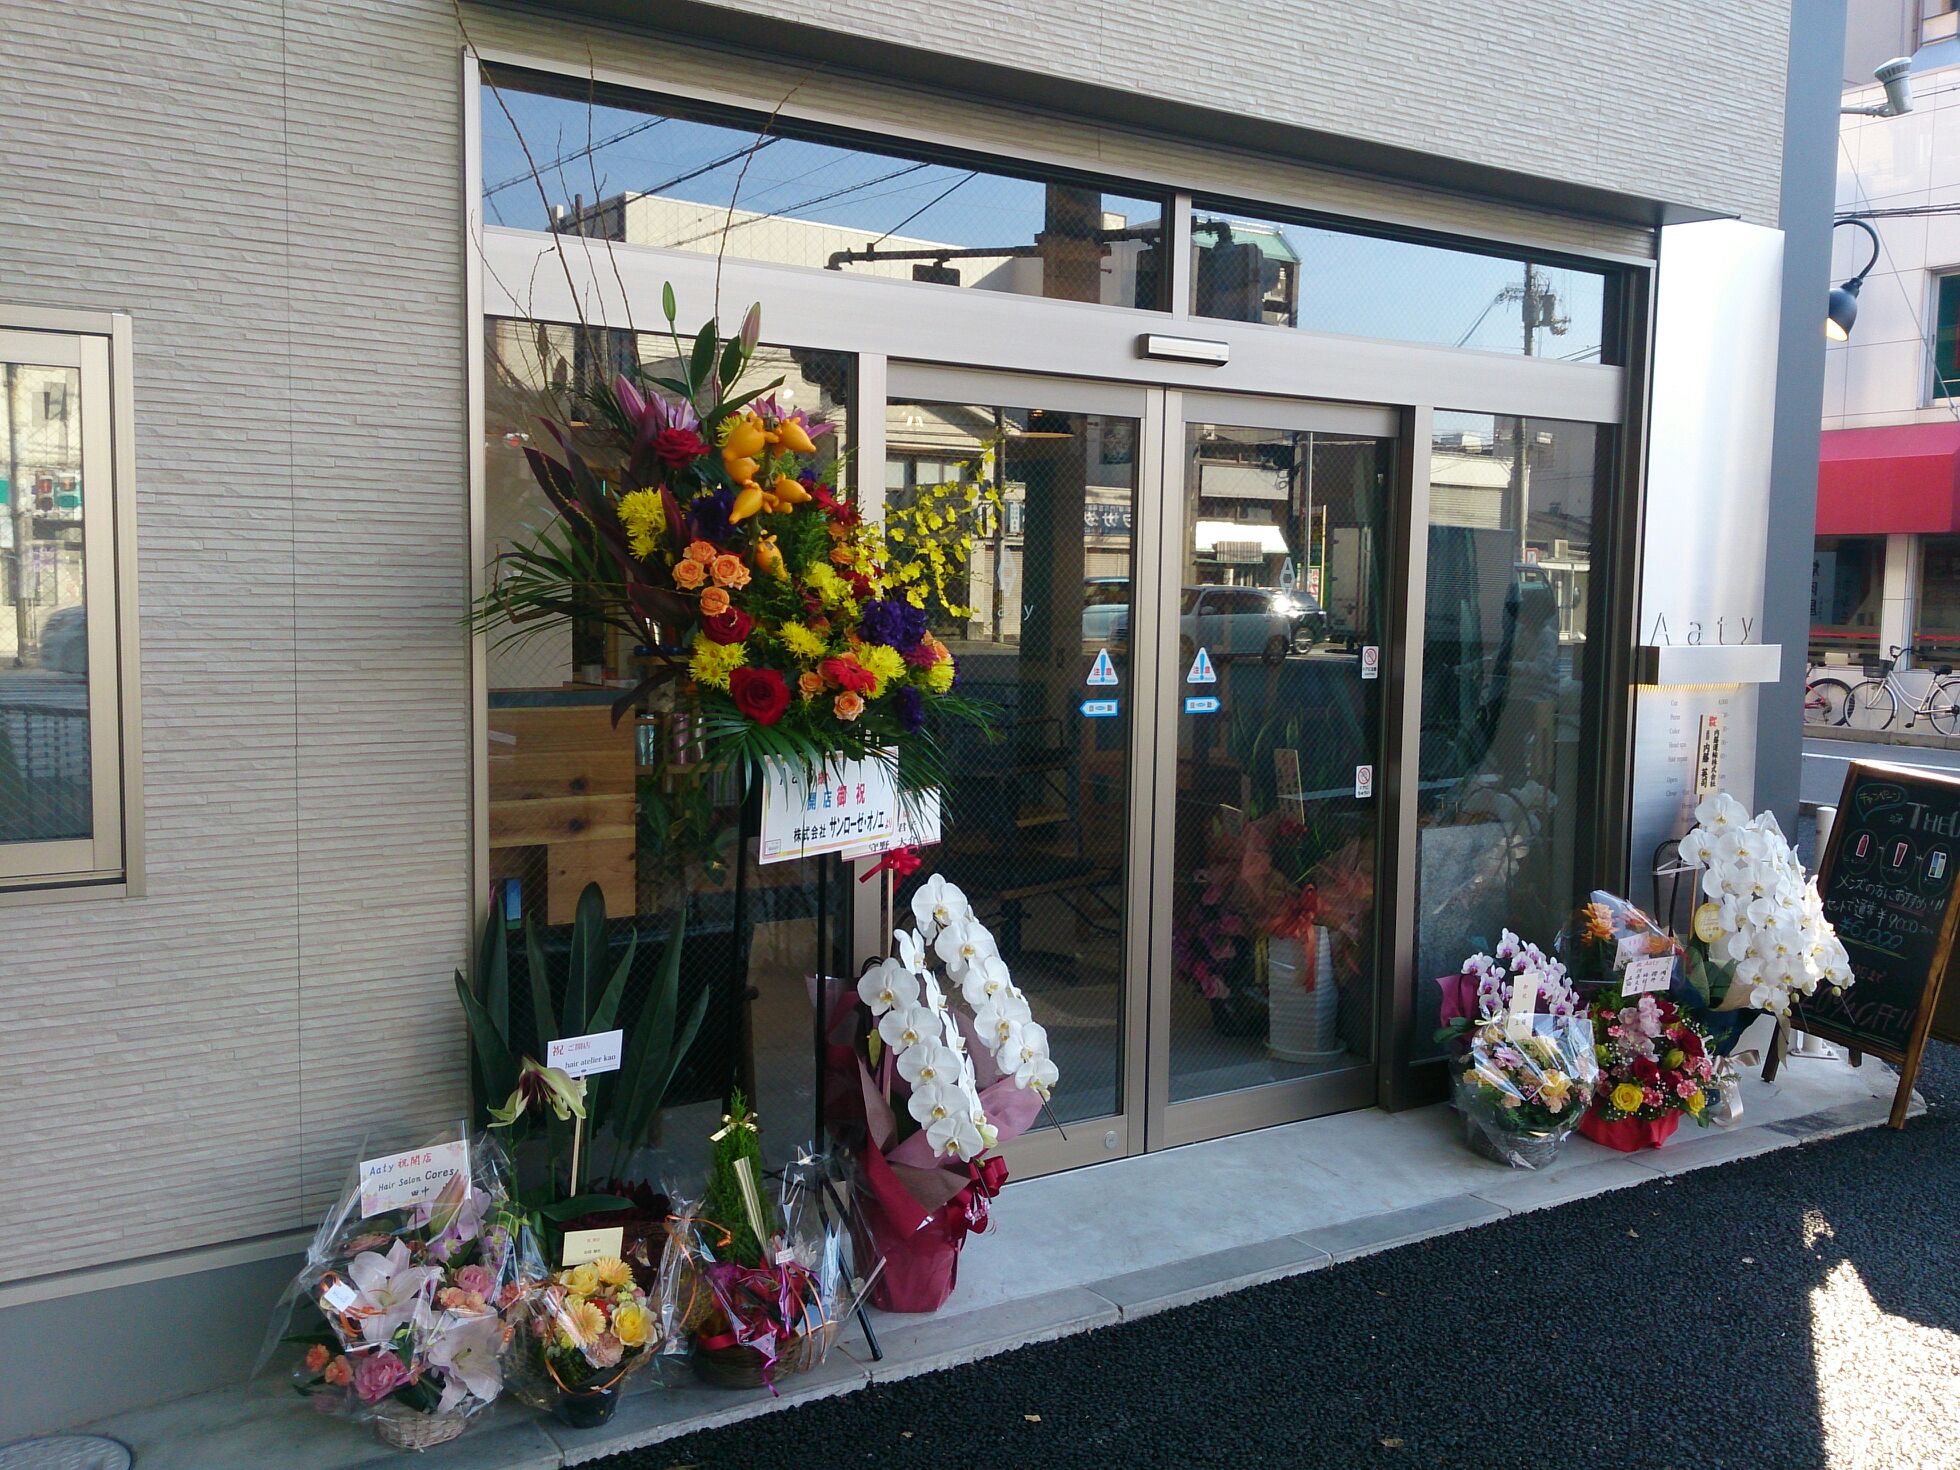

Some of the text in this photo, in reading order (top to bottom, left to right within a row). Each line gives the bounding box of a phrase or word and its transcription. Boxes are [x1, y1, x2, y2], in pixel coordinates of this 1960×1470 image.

[1650, 612, 1754, 646] Aaty
[552, 1044, 564, 1056] 祝
[580, 1056, 602, 1066] atelier
[369, 1163, 394, 1176] Aaty
[378, 1168, 455, 1192] Hair Salon Cores
